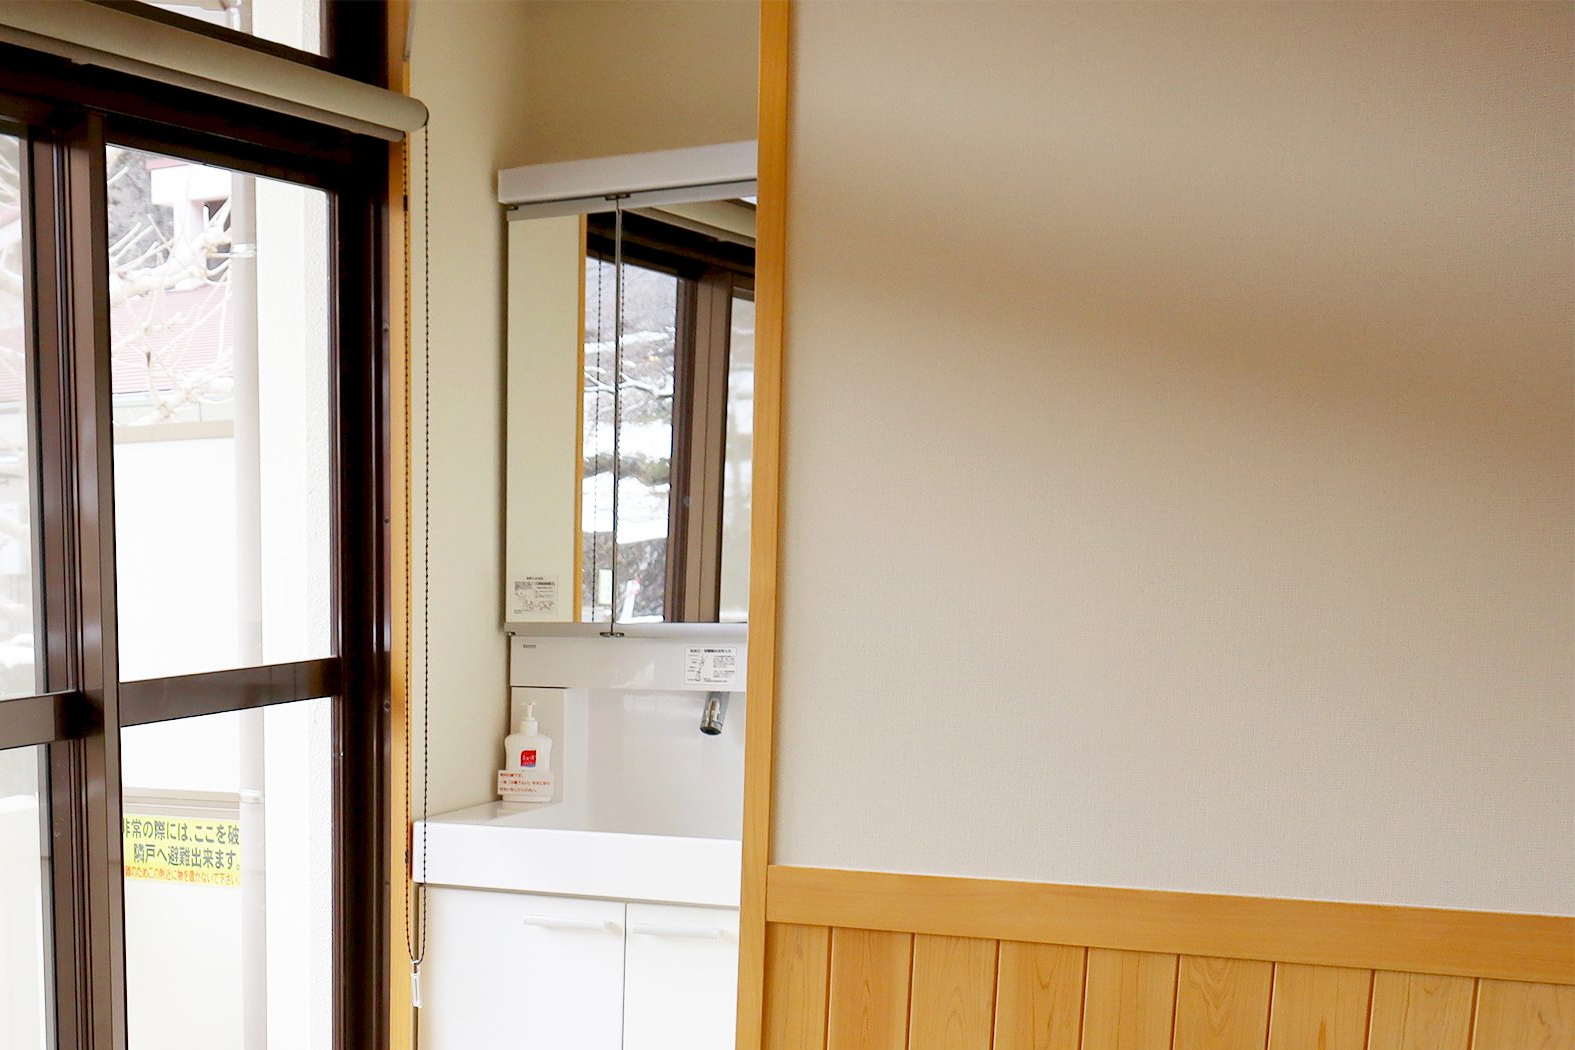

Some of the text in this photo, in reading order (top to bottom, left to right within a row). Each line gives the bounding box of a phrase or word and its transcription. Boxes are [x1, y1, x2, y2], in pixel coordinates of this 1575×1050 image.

[133, 843, 240, 871] 隣戸へ避難出来ます。
